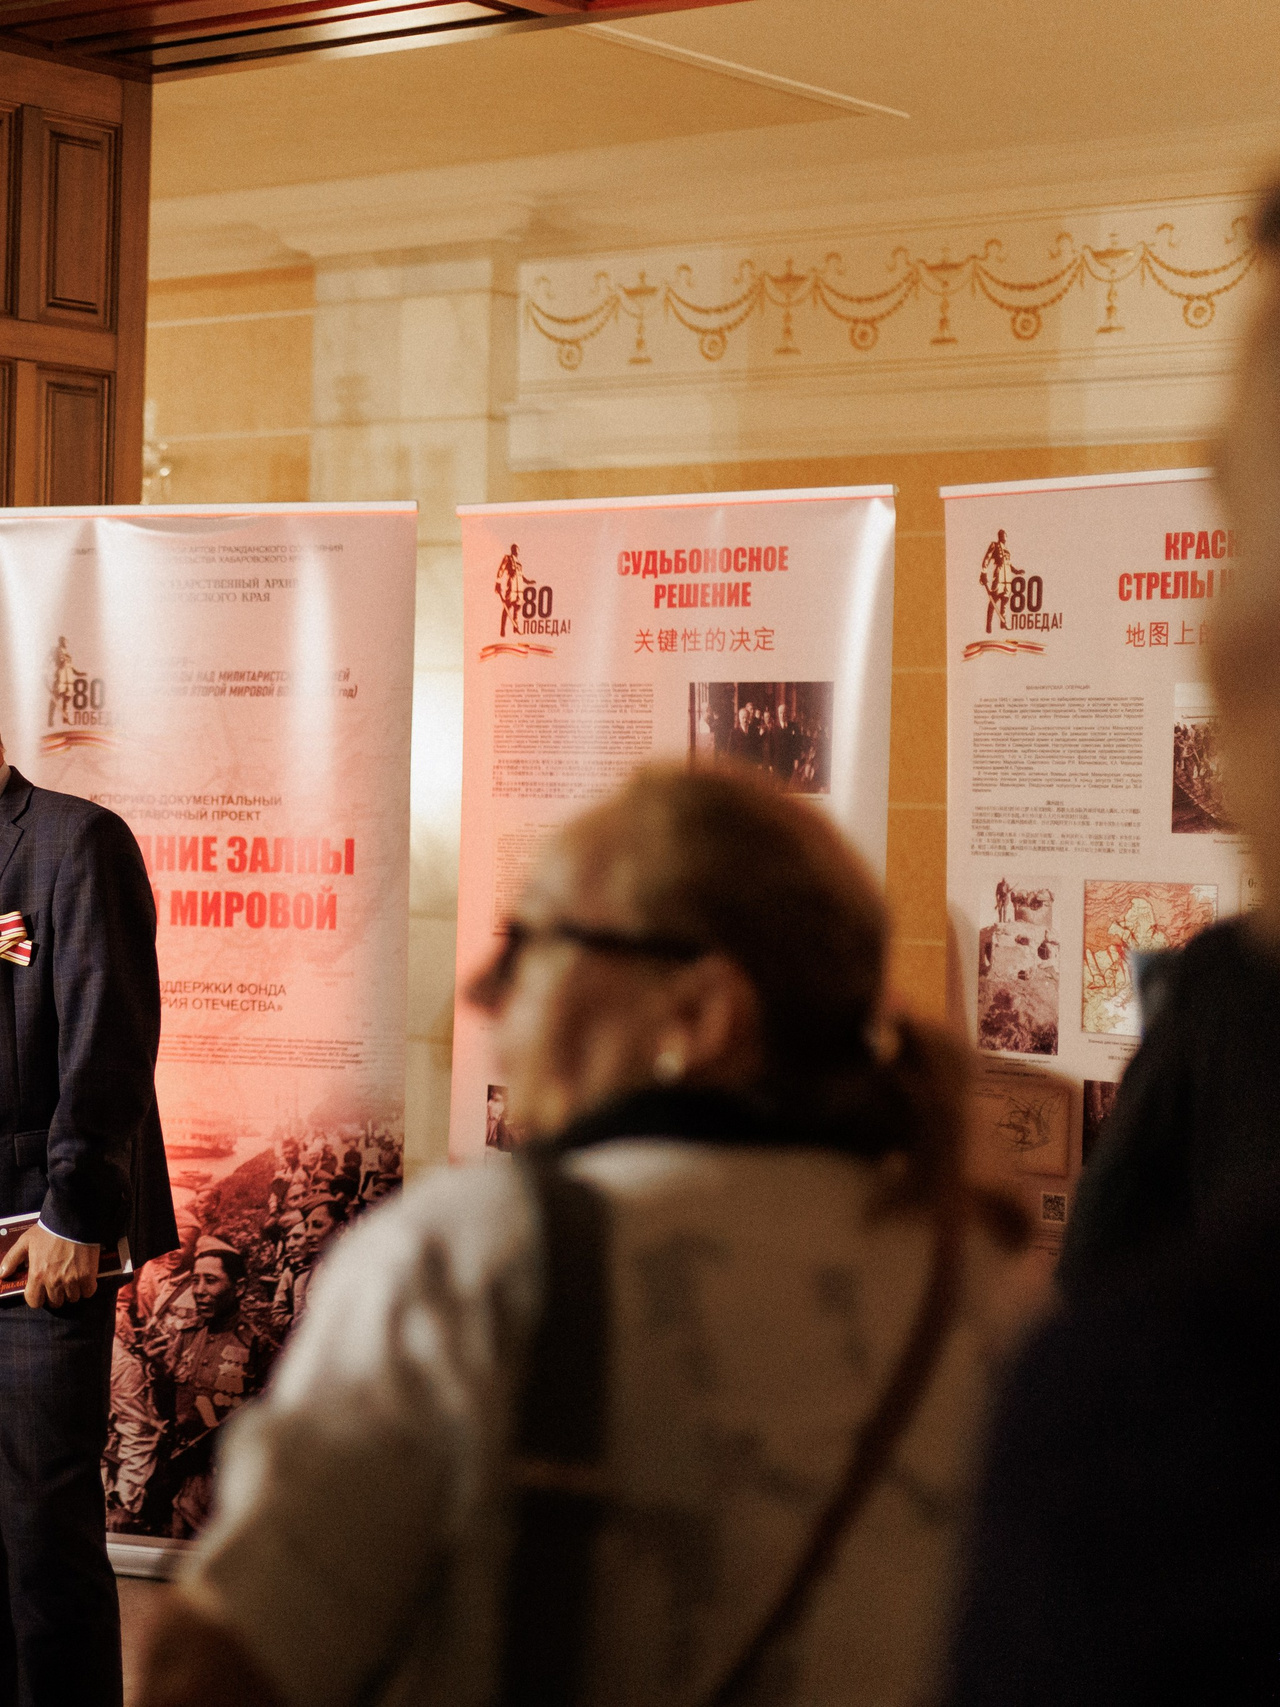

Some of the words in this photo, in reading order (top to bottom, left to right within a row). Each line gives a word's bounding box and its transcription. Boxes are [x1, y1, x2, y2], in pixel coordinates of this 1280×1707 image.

[617, 546, 789, 578] СУДЬБОНОСНОЕ
[241, 592, 271, 602] КРАЯ
[654, 582, 752, 609] РЕШЕНИЕ
[1010, 575, 1043, 612] 80
[1118, 569, 1214, 601] СТРЕЛЫ
[523, 586, 553, 619] 80
[523, 618, 571, 636] ПОБЕДА!
[1010, 611, 1064, 632] ПОБЕДА!
[634, 626, 776, 654] 关键性的决定
[73, 678, 106, 711] 80
[228, 683, 275, 697] МИРОВОЙ
[211, 810, 262, 821] ПРОЕКТ
[226, 836, 355, 875] ЗАЛПЫ
[170, 884, 338, 930] МИРОВОЙ
[160, 980, 233, 996] ОДДЕРЖКИ
[236, 982, 287, 997] ФОНДА
[191, 999, 284, 1012] ОТЕЧЕСТВА»
